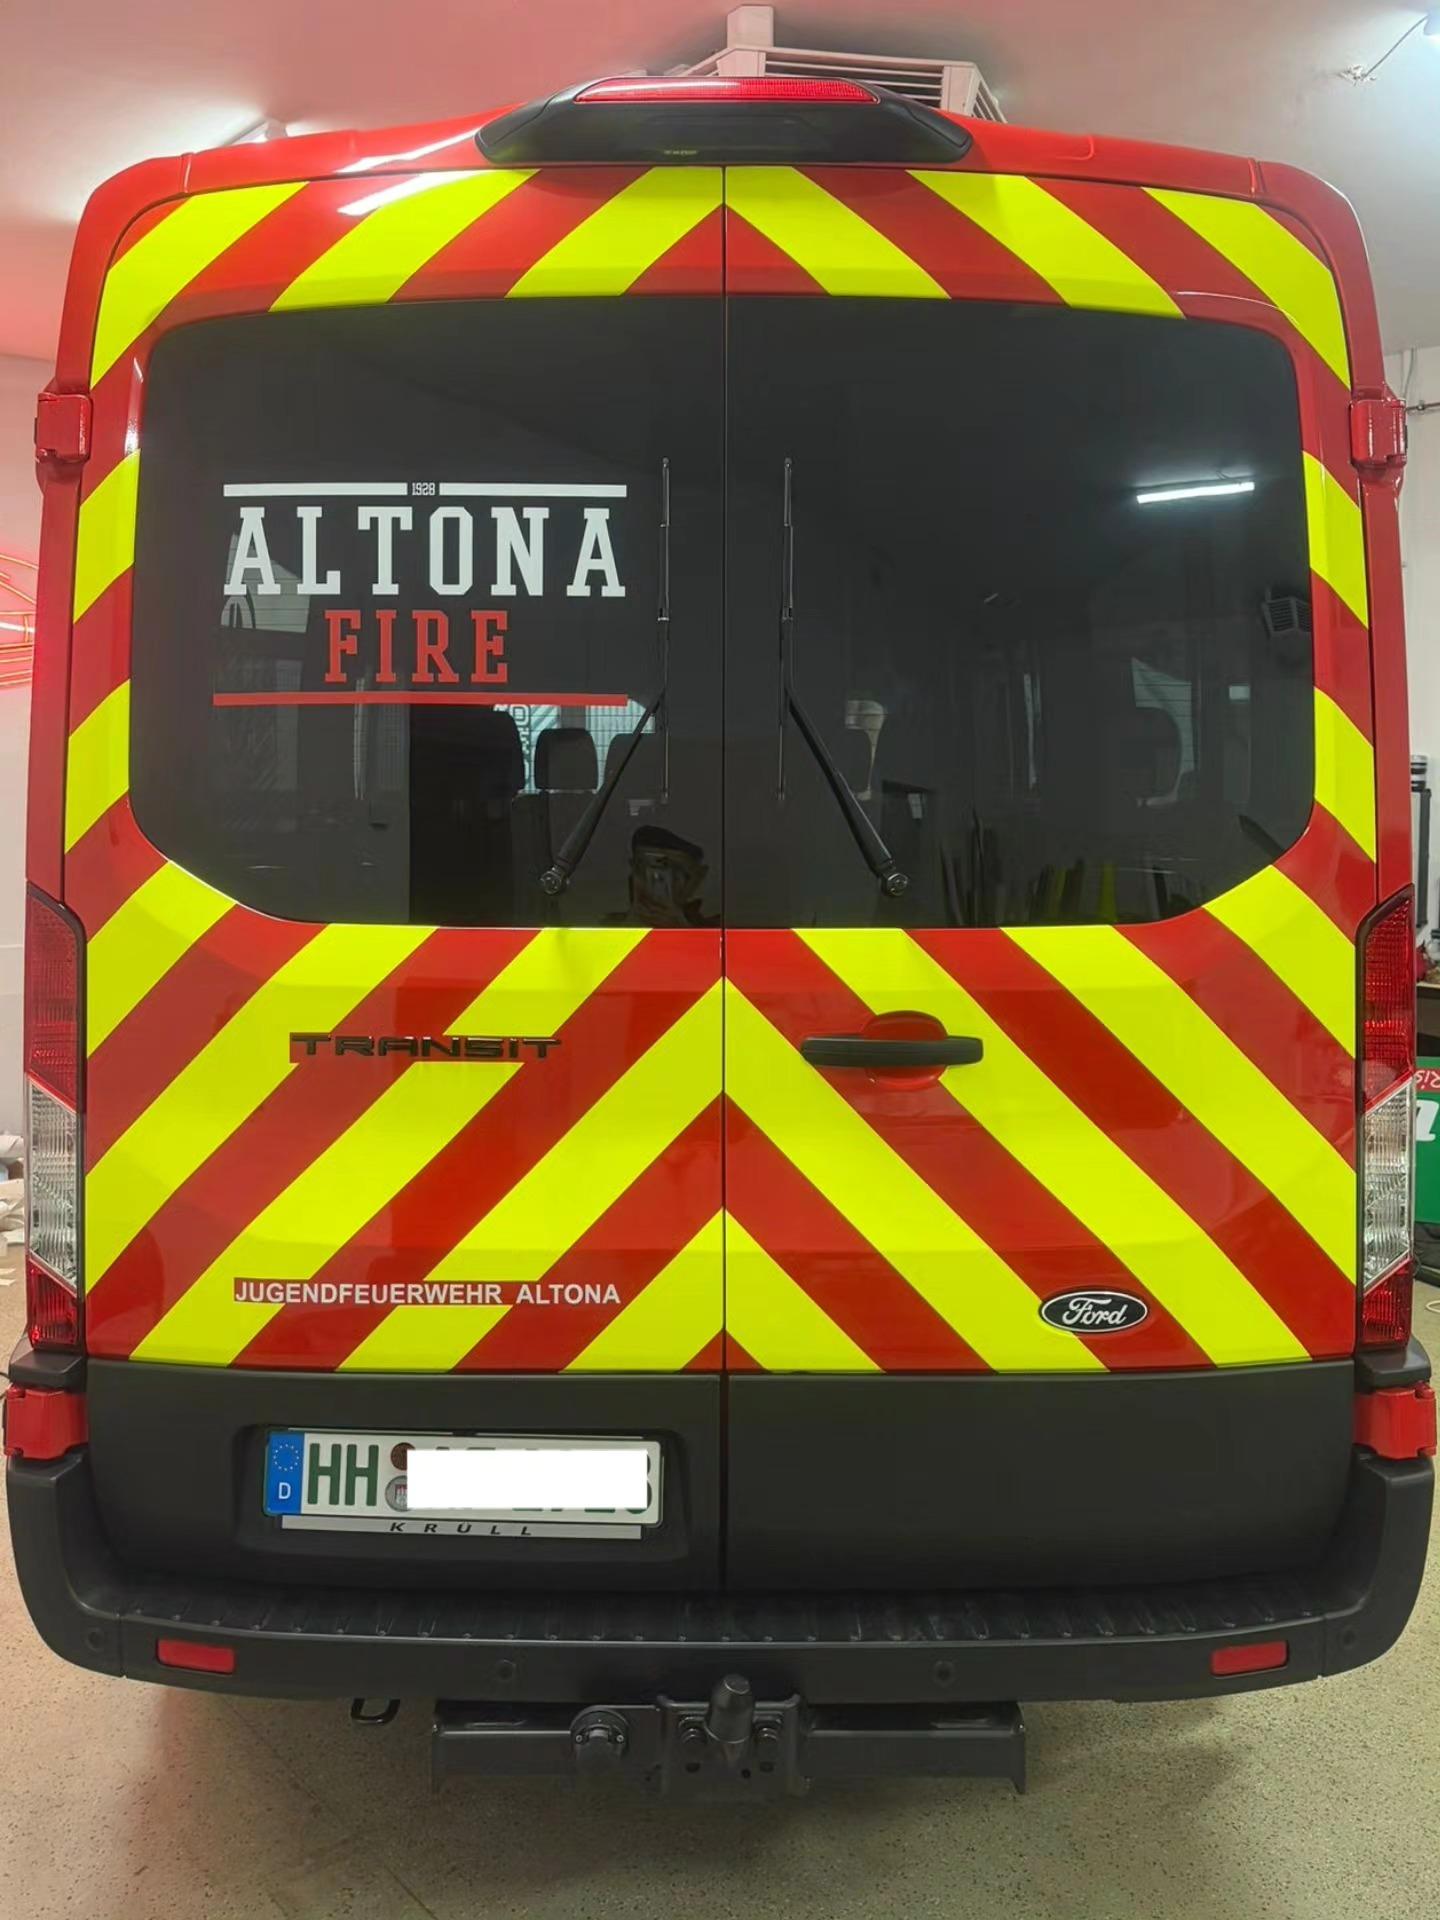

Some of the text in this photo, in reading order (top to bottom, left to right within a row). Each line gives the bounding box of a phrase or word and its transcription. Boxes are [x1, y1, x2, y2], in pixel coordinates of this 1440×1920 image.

[412, 482, 435, 496] 1928
[223, 506, 626, 597] ALTONA
[324, 609, 508, 683] FIRE
[291, 1035, 562, 1058] TRANSIT
[235, 1281, 621, 1305] JUGENDFEUERWEHR ALTONA
[1062, 1297, 1128, 1325] Ford
[307, 1442, 380, 1506] HH
[277, 1481, 292, 1500] D
